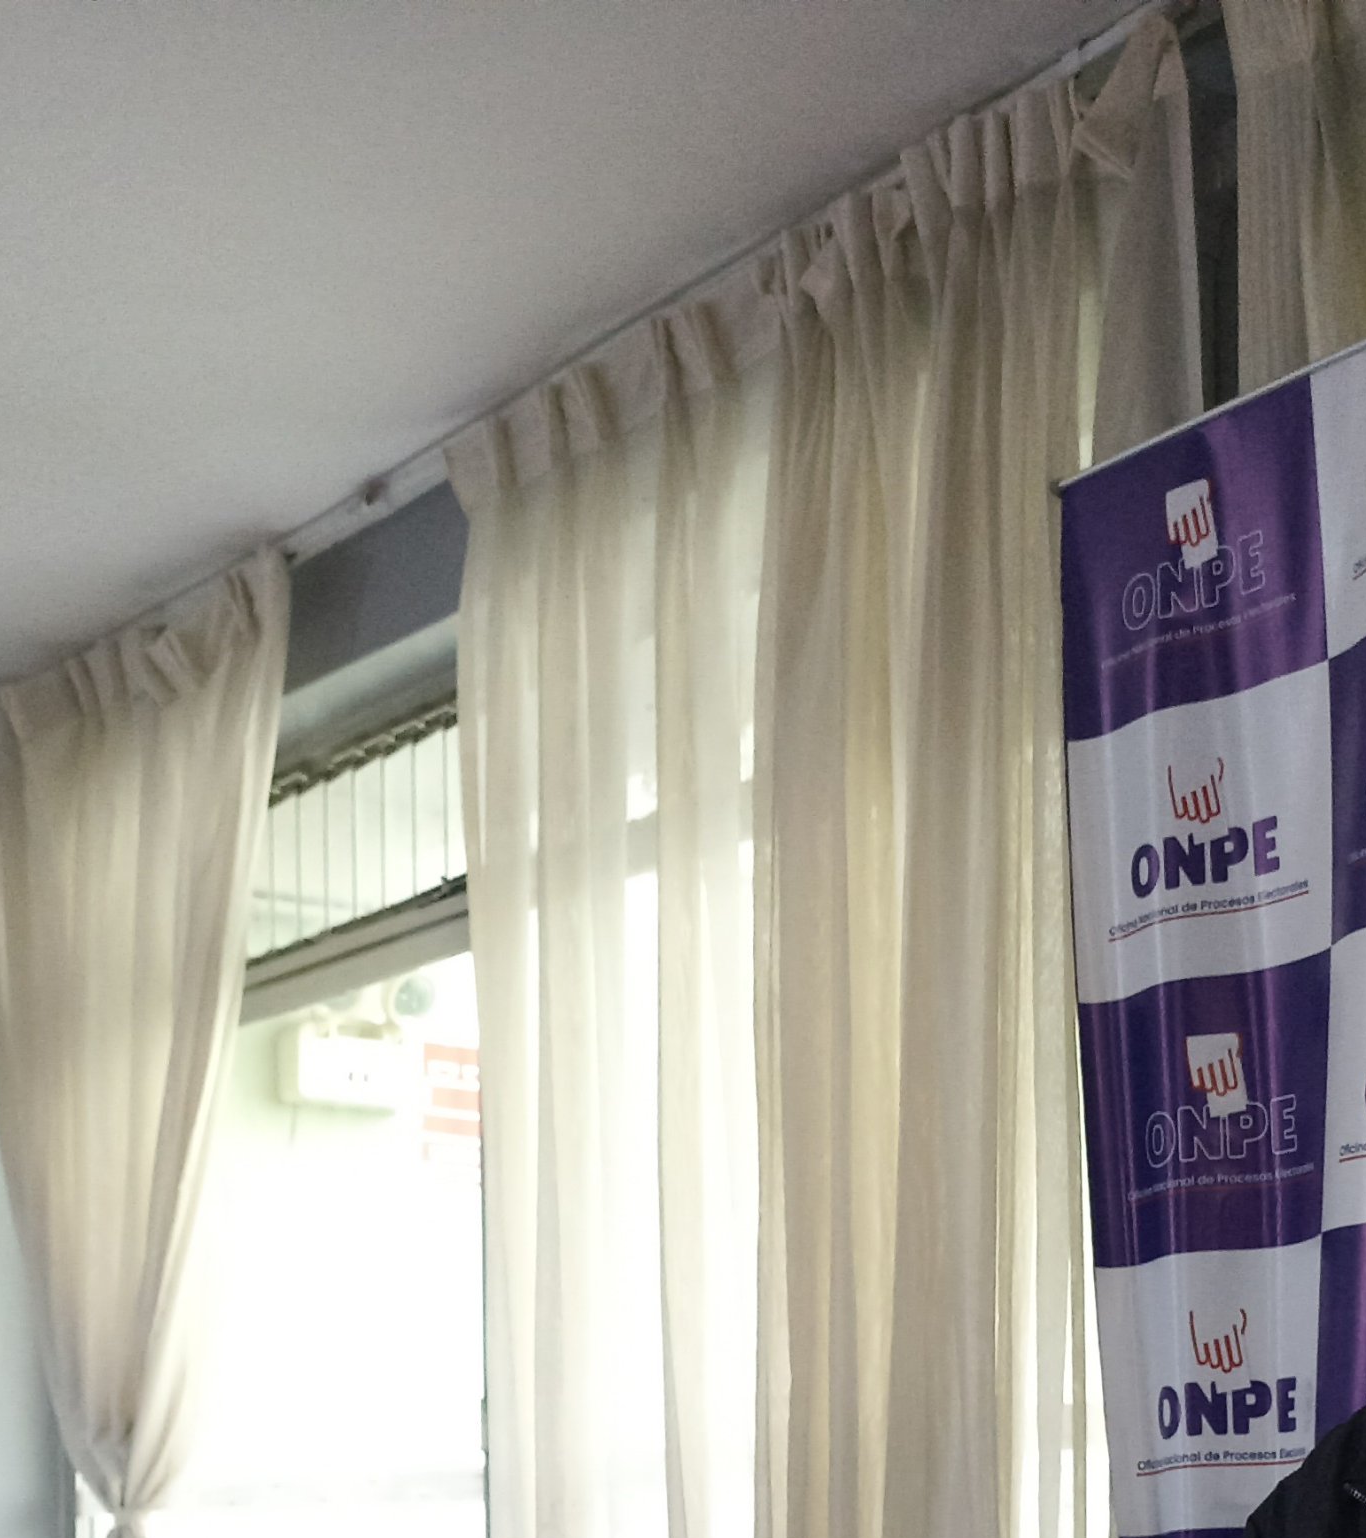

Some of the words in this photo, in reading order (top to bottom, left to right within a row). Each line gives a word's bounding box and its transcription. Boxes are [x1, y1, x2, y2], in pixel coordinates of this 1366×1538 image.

[1122, 530, 1266, 631] ONPE
[1130, 815, 1281, 899] ONPE
[1145, 1093, 1299, 1169] ONPE
[1157, 1375, 1298, 1440] ONPE
